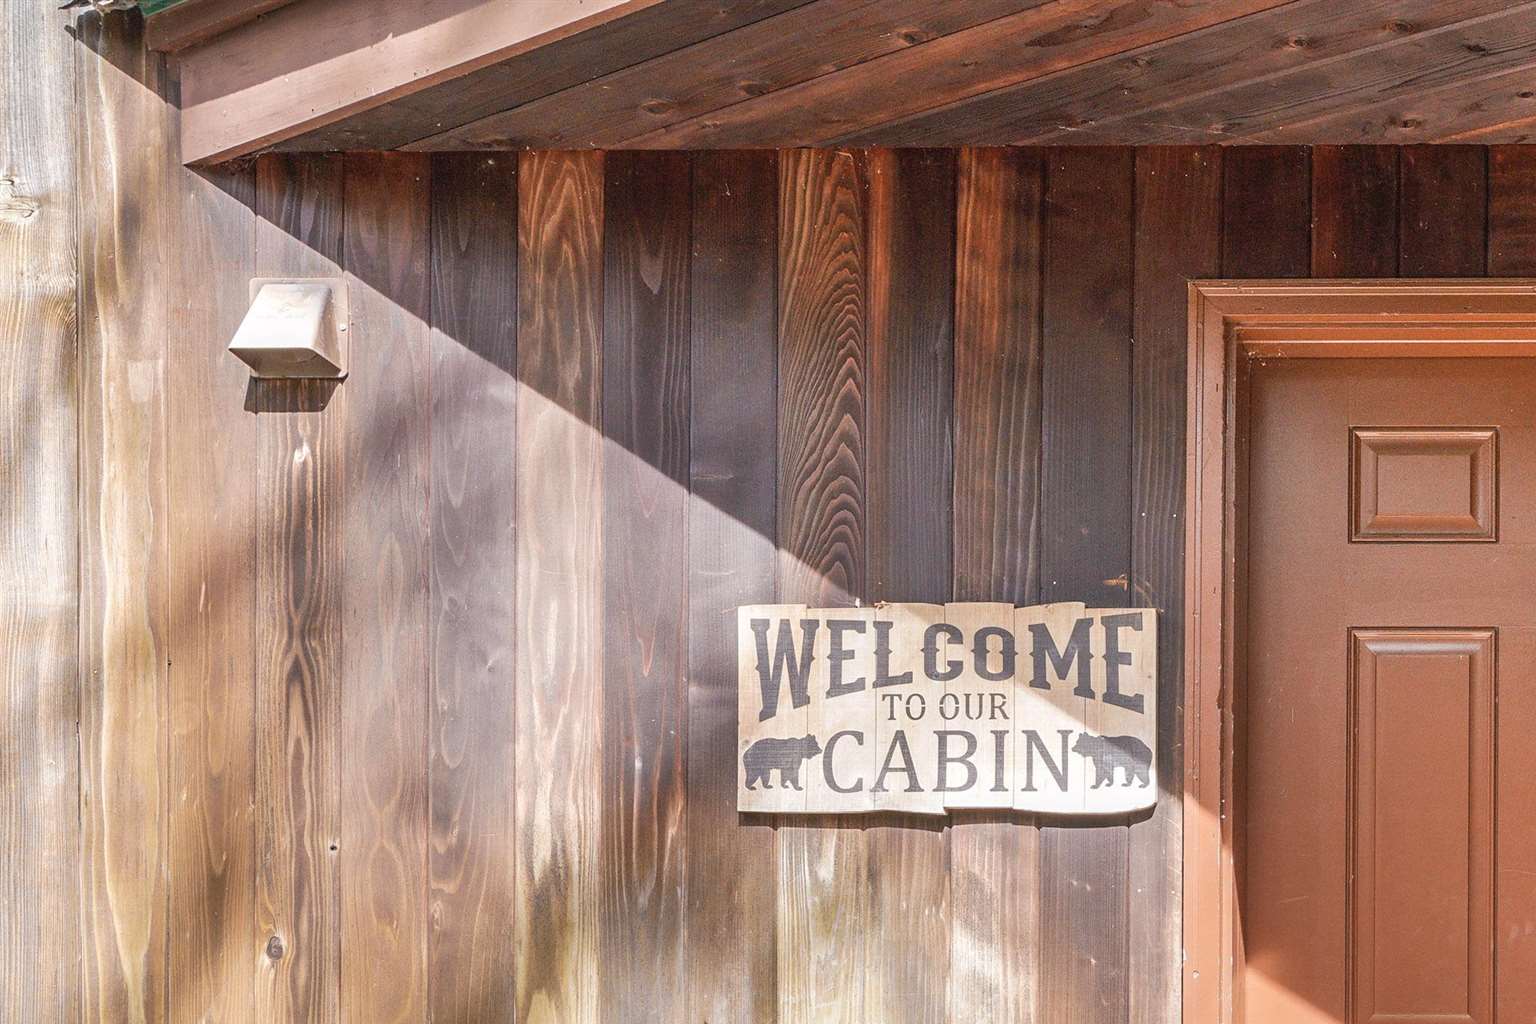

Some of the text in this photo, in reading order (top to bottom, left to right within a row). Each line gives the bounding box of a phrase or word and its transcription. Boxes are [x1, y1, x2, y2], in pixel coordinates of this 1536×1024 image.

[750, 612, 1144, 722] WELCOME
[881, 693, 1010, 721] TO OUR
[822, 729, 1073, 794] CABIN
